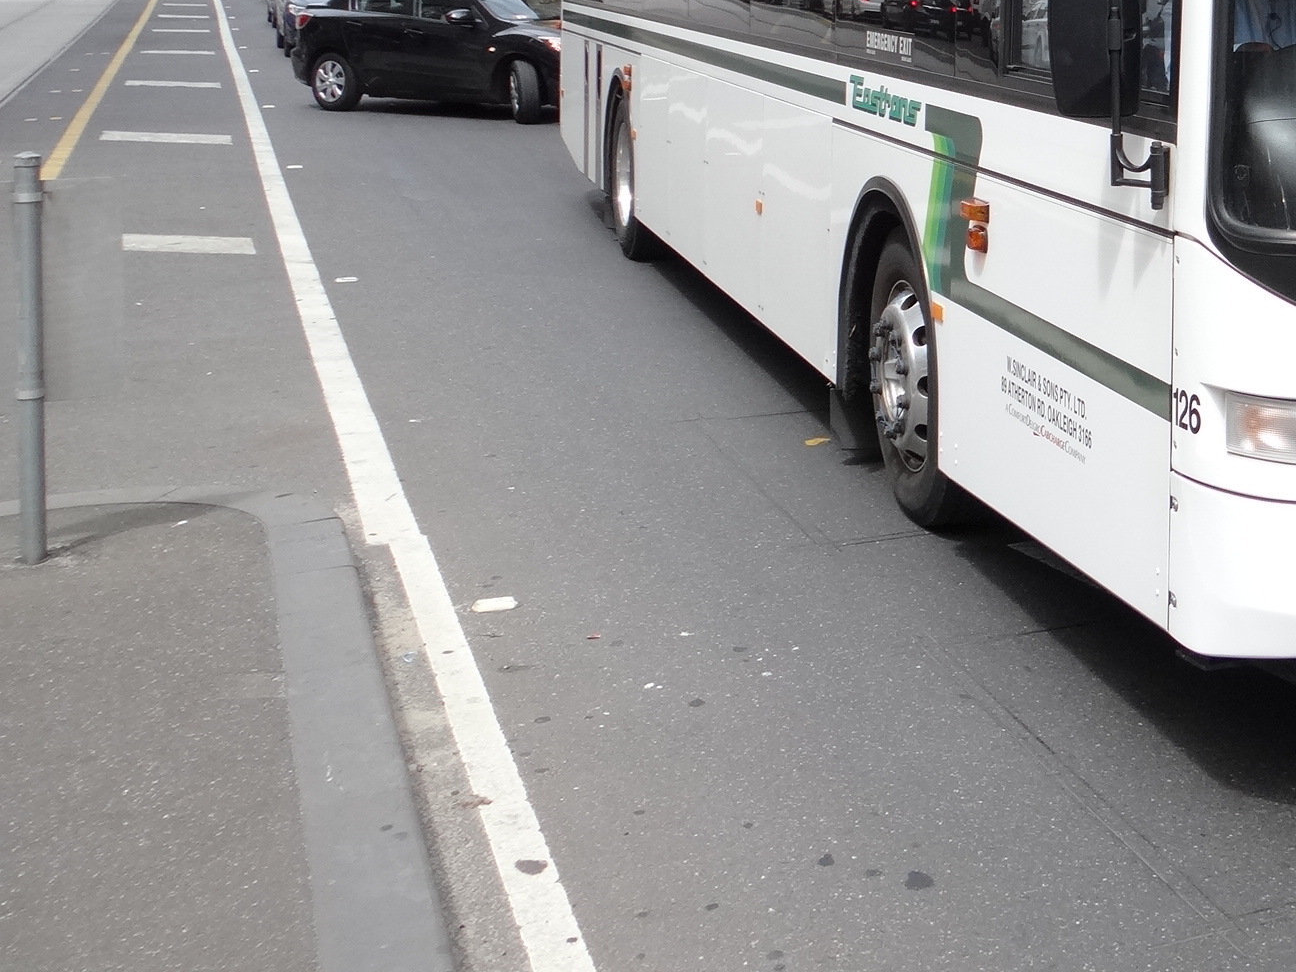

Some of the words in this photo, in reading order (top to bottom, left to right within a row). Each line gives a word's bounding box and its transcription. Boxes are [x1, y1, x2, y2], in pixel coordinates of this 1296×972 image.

[866, 30, 899, 53] EMERGENCY
[899, 36, 913, 56] EXIT
[849, 73, 922, 127] Eastrans
[1001, 375, 1007, 394] 89
[1008, 379, 1037, 413] ATHERTON
[1037, 397, 1047, 420] RD.
[1047, 405, 1078, 440] OAKLEIGH
[1078, 424, 1093, 449] 3166
[1038, 374, 1042, 392] &
[1043, 377, 1059, 403] SONS
[1060, 387, 1073, 412] PTY.
[1073, 395, 1088, 420] LTD.
[1173, 387, 1201, 434] 126
